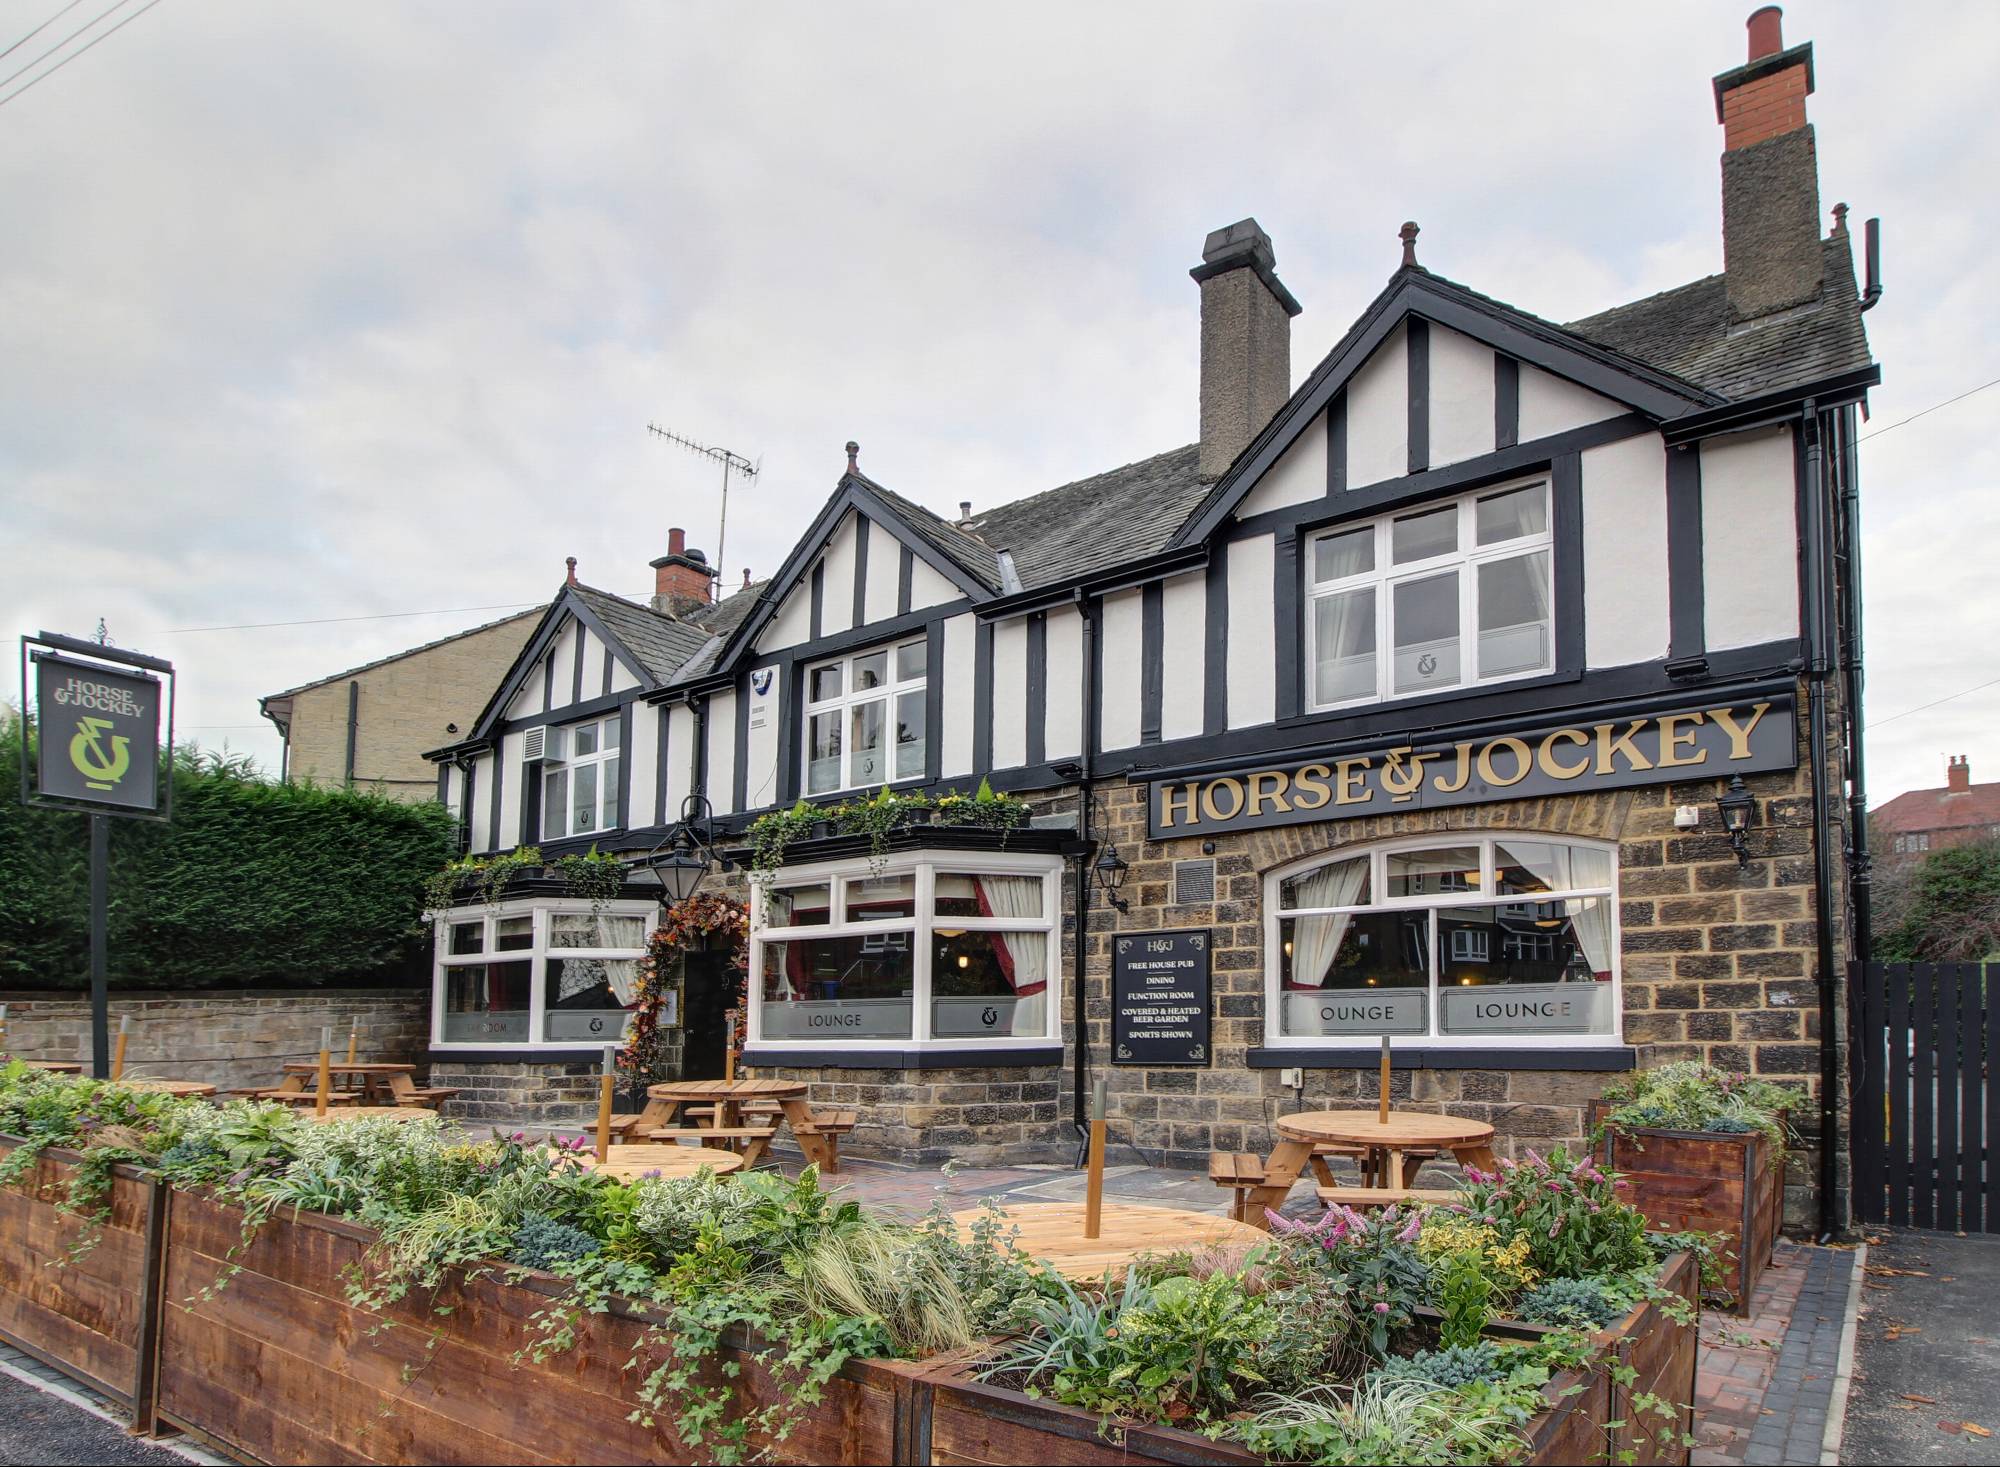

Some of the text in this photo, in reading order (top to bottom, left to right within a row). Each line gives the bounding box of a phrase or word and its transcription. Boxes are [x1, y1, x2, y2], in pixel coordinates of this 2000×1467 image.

[67, 678, 134, 704] HORSE
[1159, 756, 1375, 828] HORSE
[1433, 702, 1772, 793] JOCKEY
[1147, 940, 1174, 953] H&J
[1128, 960, 1195, 970] FREE HOUSE PUB
[1128, 991, 1195, 1000] FUNCTION ROOM
[1160, 1007, 1167, 1015] &
[1314, 1005, 1395, 1021] OUNGE
[808, 1014, 862, 1027] LOUNGE
[1129, 1031, 1160, 1039] SPORTS
